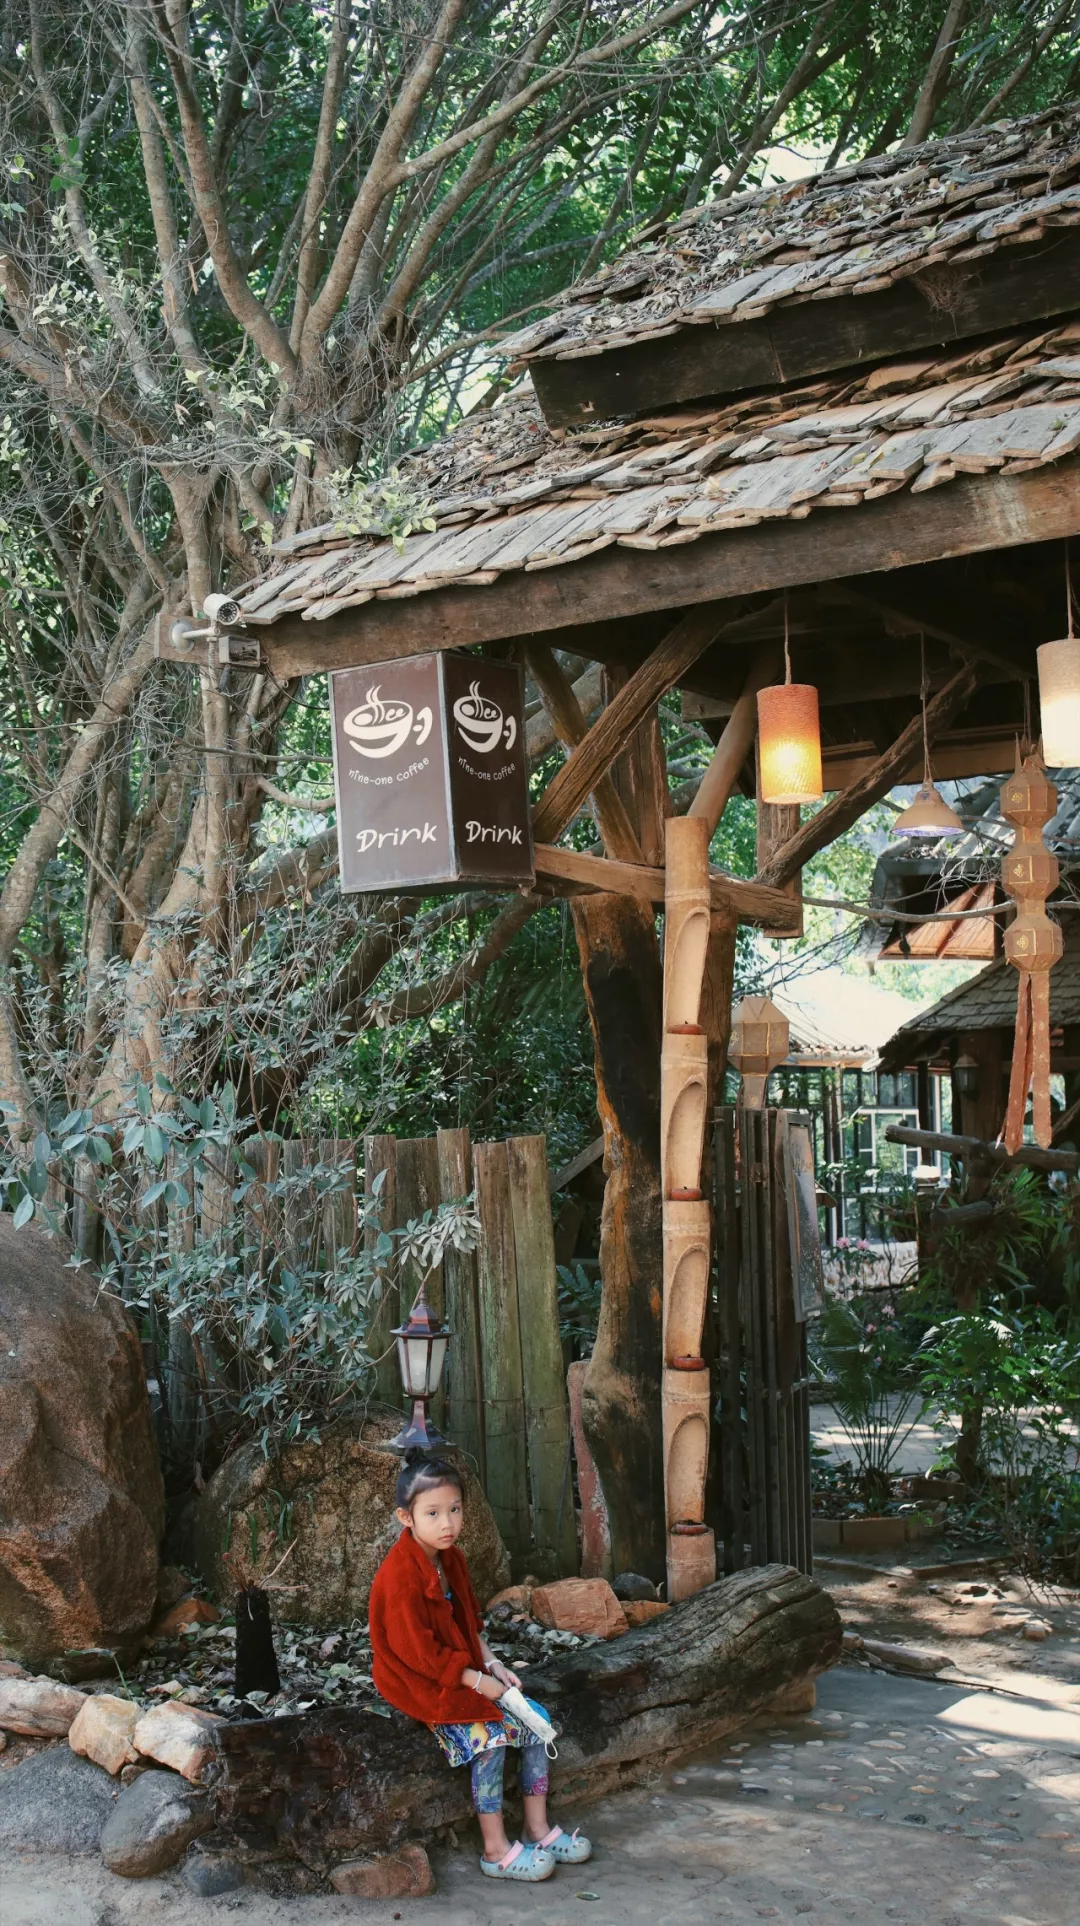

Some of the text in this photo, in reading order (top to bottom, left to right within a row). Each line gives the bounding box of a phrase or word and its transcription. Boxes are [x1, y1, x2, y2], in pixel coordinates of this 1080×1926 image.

[348, 757, 430, 786] nine-one coffee
[458, 756, 516, 781] nine-one coffee
[355, 822, 438, 853] Drink
[465, 820, 523, 845] Drink
